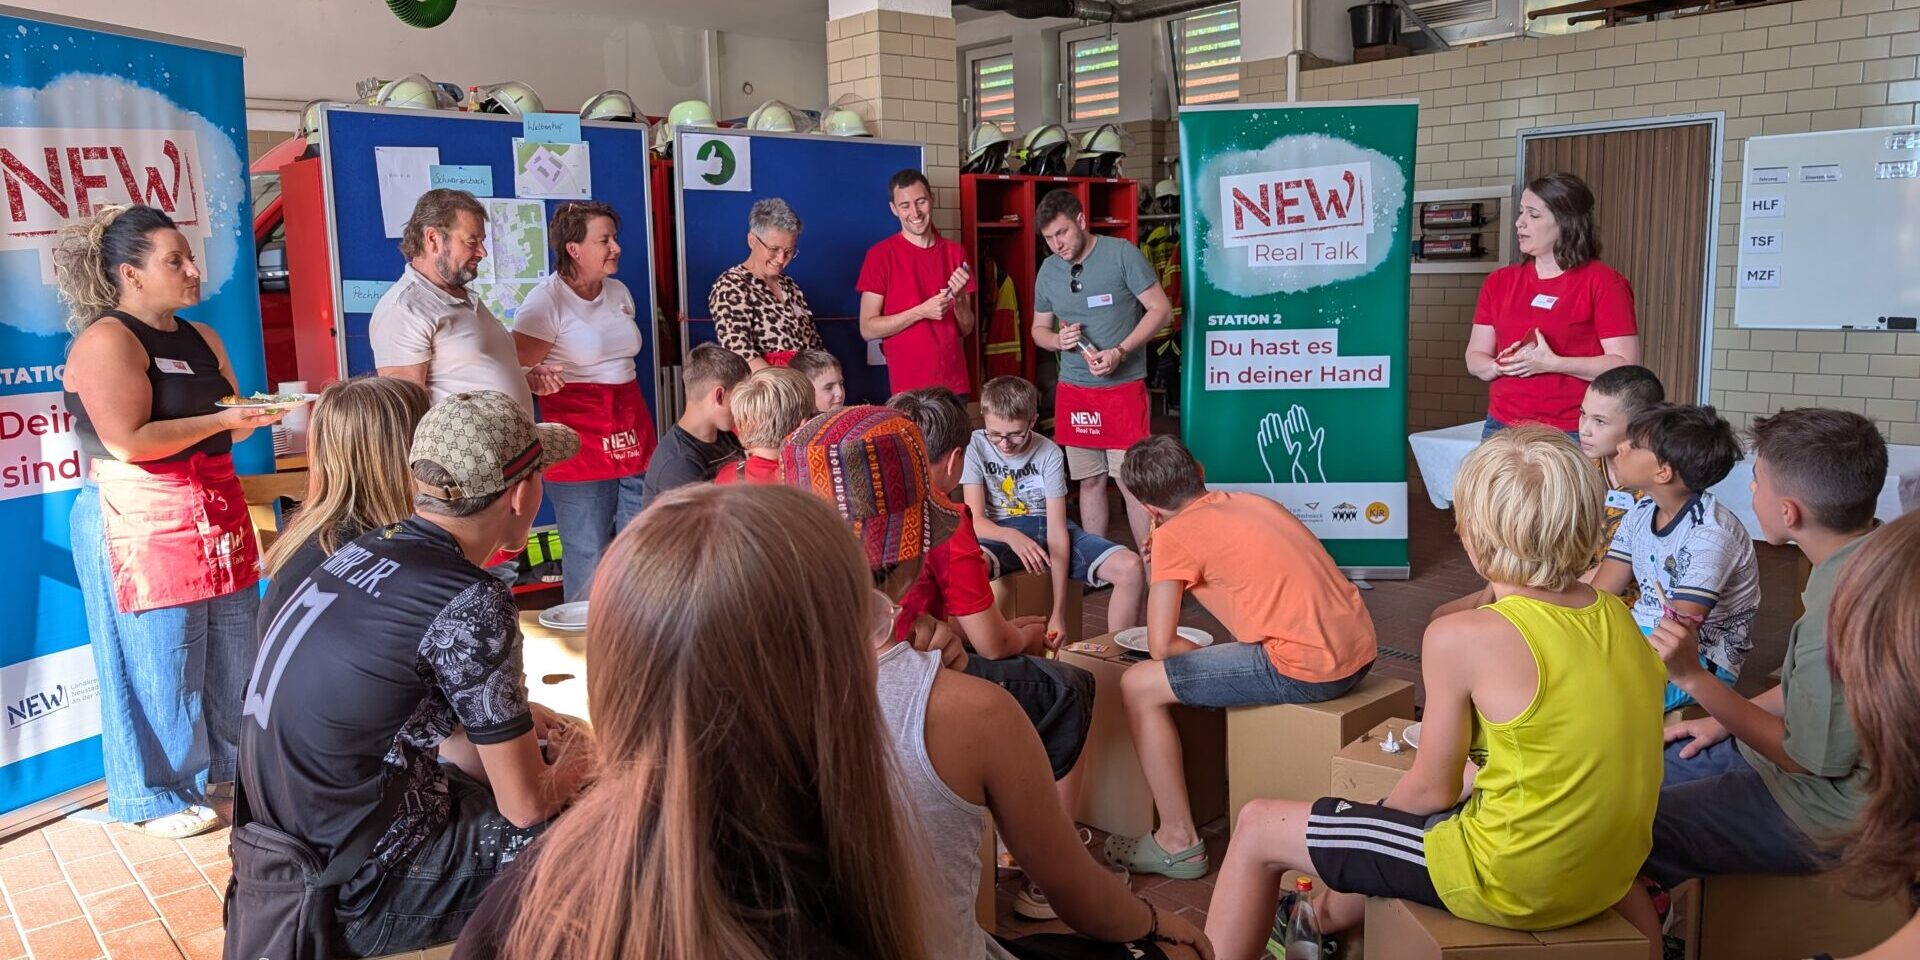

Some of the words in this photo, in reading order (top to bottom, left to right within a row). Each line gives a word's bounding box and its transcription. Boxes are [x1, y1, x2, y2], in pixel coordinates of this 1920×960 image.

[0, 139, 181, 222] NEW
[1232, 170, 1355, 231] NEW
[1752, 200, 1779, 211] HLF
[1750, 236, 1775, 246] TSF
[1255, 242, 1304, 262] Real
[1311, 241, 1359, 260] Talk
[1747, 270, 1775, 281] MZF
[1208, 314, 1270, 326] STATION
[1273, 314, 1282, 324] 2
[1210, 339, 1242, 356] Du
[1250, 338, 1300, 356] hast
[1307, 341, 1332, 355] es
[0, 364, 65, 385] TATIO
[1210, 367, 1230, 384] in
[1238, 366, 1313, 384] deiner
[1321, 364, 1383, 382] Hand
[1070, 411, 1099, 425] NEW
[602, 429, 637, 452] NEW
[626, 450, 640, 458] Talk
[3, 450, 81, 488] sind
[346, 557, 401, 598] JR.
[71, 685, 99, 697] Neustad
[7, 684, 63, 726] NEW
